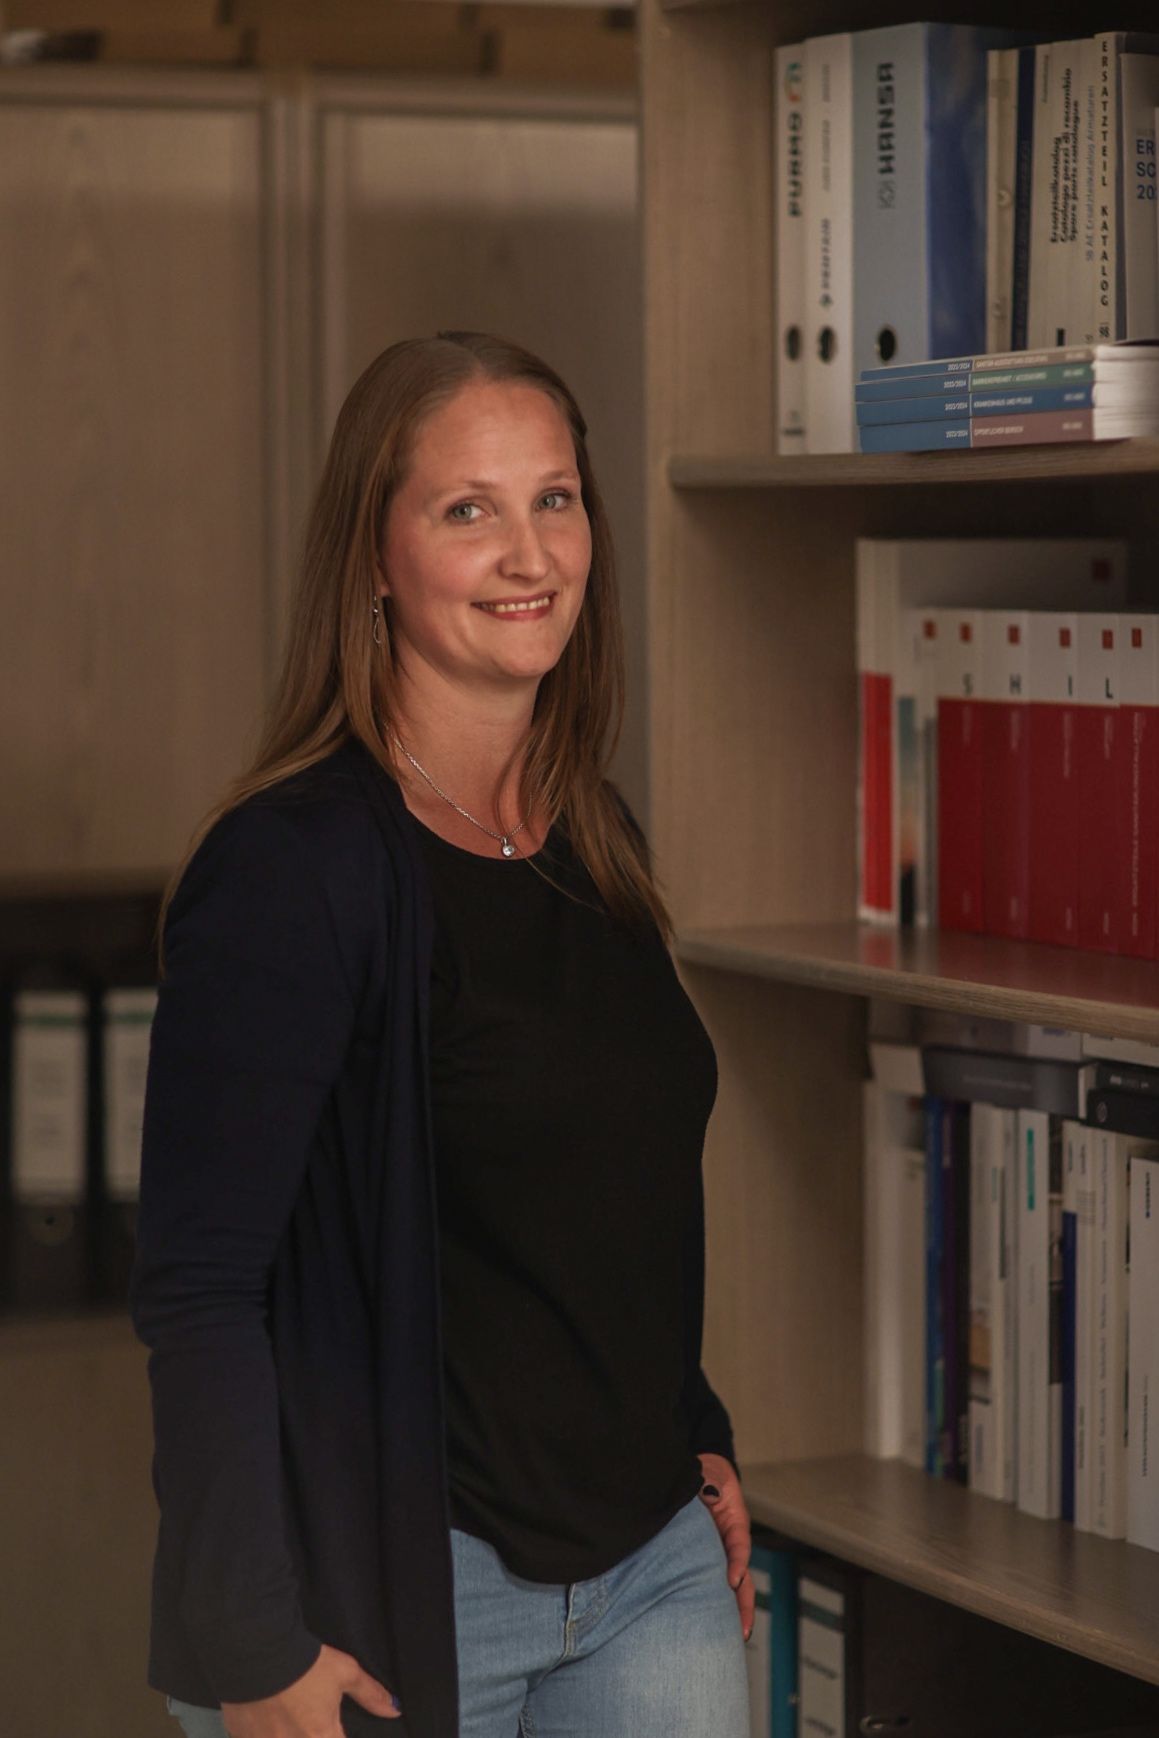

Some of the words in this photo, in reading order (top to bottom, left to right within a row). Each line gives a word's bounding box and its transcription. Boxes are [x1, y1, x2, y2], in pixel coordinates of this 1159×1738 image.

[788, 111, 802, 217] PURMO
[877, 62, 894, 174] HANSA
[1101, 41, 1109, 187] ERSATZTEIL
[1137, 185, 1157, 200] 20
[1100, 206, 1109, 306] KATALOG
[1010, 673, 1021, 695] H
[1105, 677, 1114, 699] L
